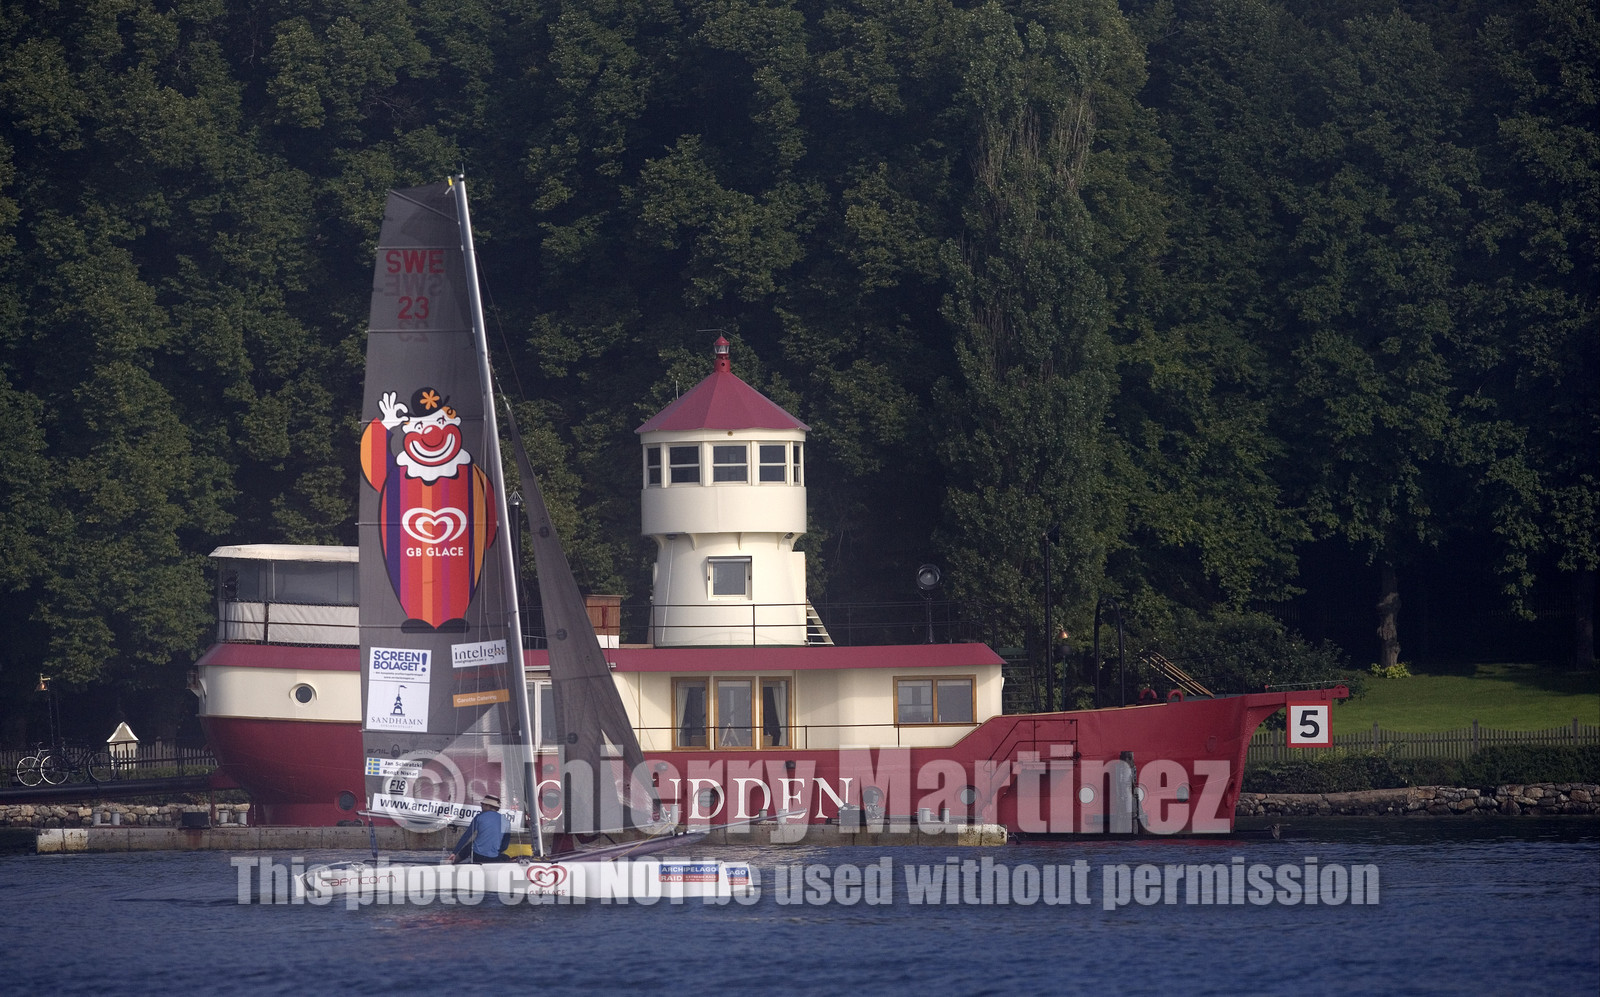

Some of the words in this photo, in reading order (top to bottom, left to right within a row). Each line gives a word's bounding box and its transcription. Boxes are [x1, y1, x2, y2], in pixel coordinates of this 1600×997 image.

[385, 250, 445, 274] SWE
[397, 296, 430, 319] 23
[406, 547, 422, 557] GB
[426, 547, 464, 557] GLACE
[373, 650, 420, 662] SCREEN
[454, 643, 506, 661] intelight
[373, 661, 420, 671] BOLAGET
[371, 716, 424, 726] SANDHAMN
[1299, 709, 1320, 738] 5
[389, 779, 406, 791] F18
